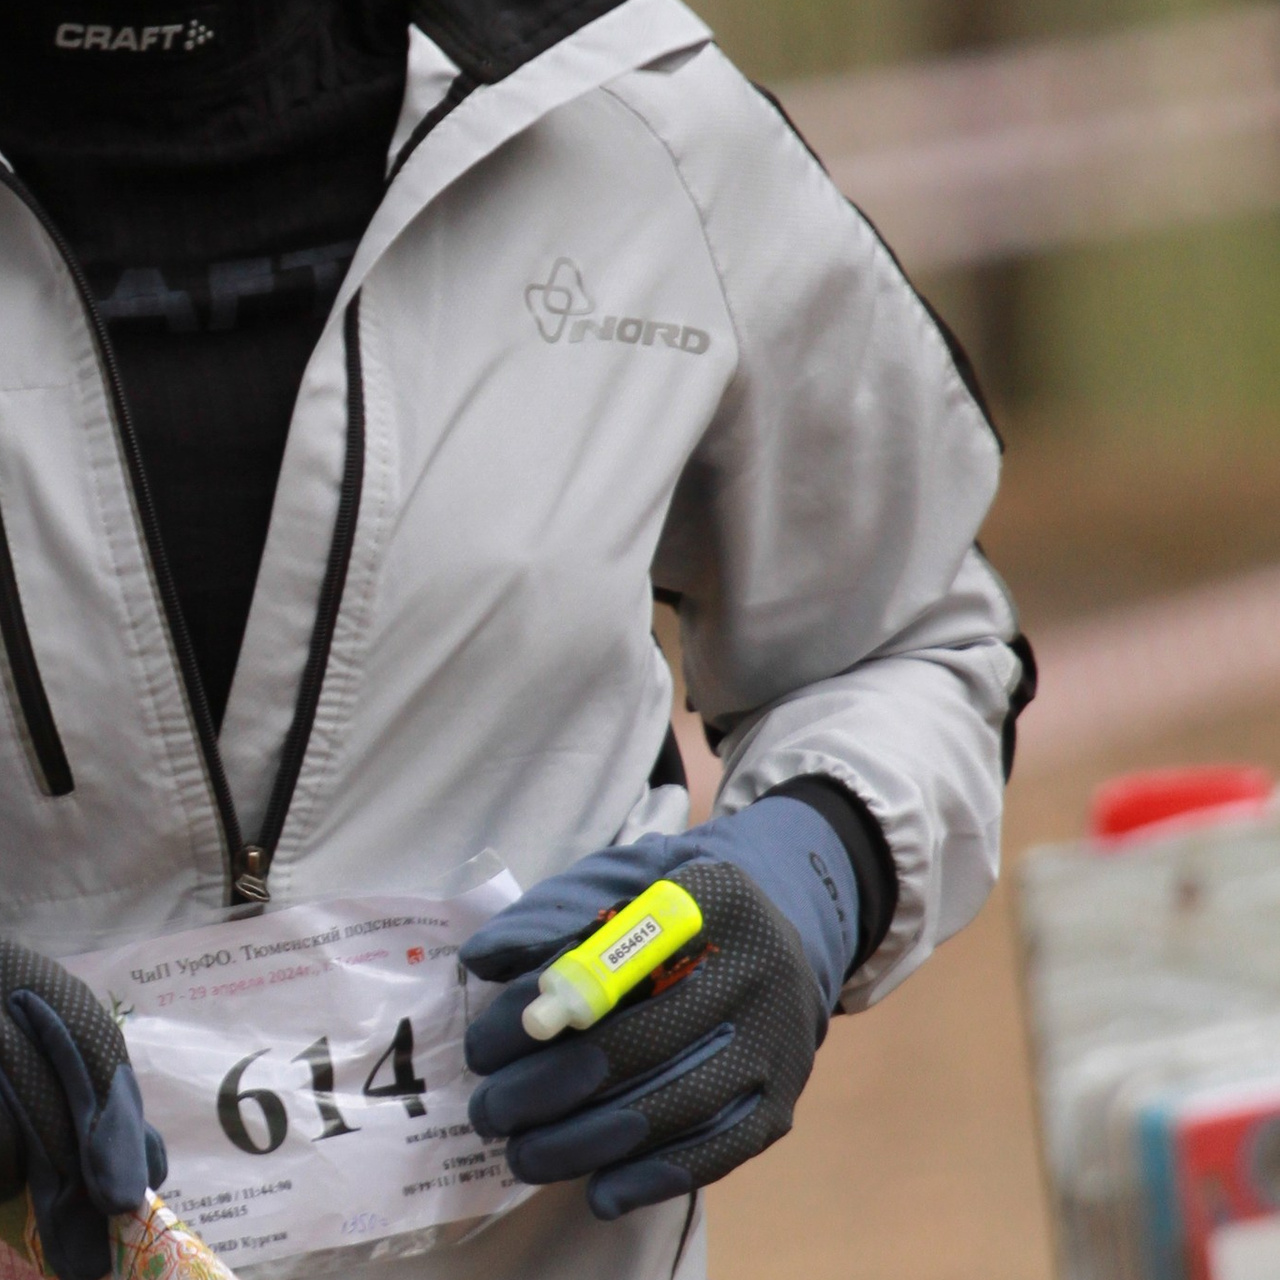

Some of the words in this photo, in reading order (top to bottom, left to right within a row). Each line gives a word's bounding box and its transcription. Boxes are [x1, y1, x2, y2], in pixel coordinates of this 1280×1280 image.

[55, 22, 184, 51] CRAFT
[569, 316, 711, 355] NORD
[131, 962, 172, 985] ЧиП
[239, 926, 342, 961] Тюменский
[608, 921, 657, 965] 8654615
[216, 1016, 428, 1156] 614
